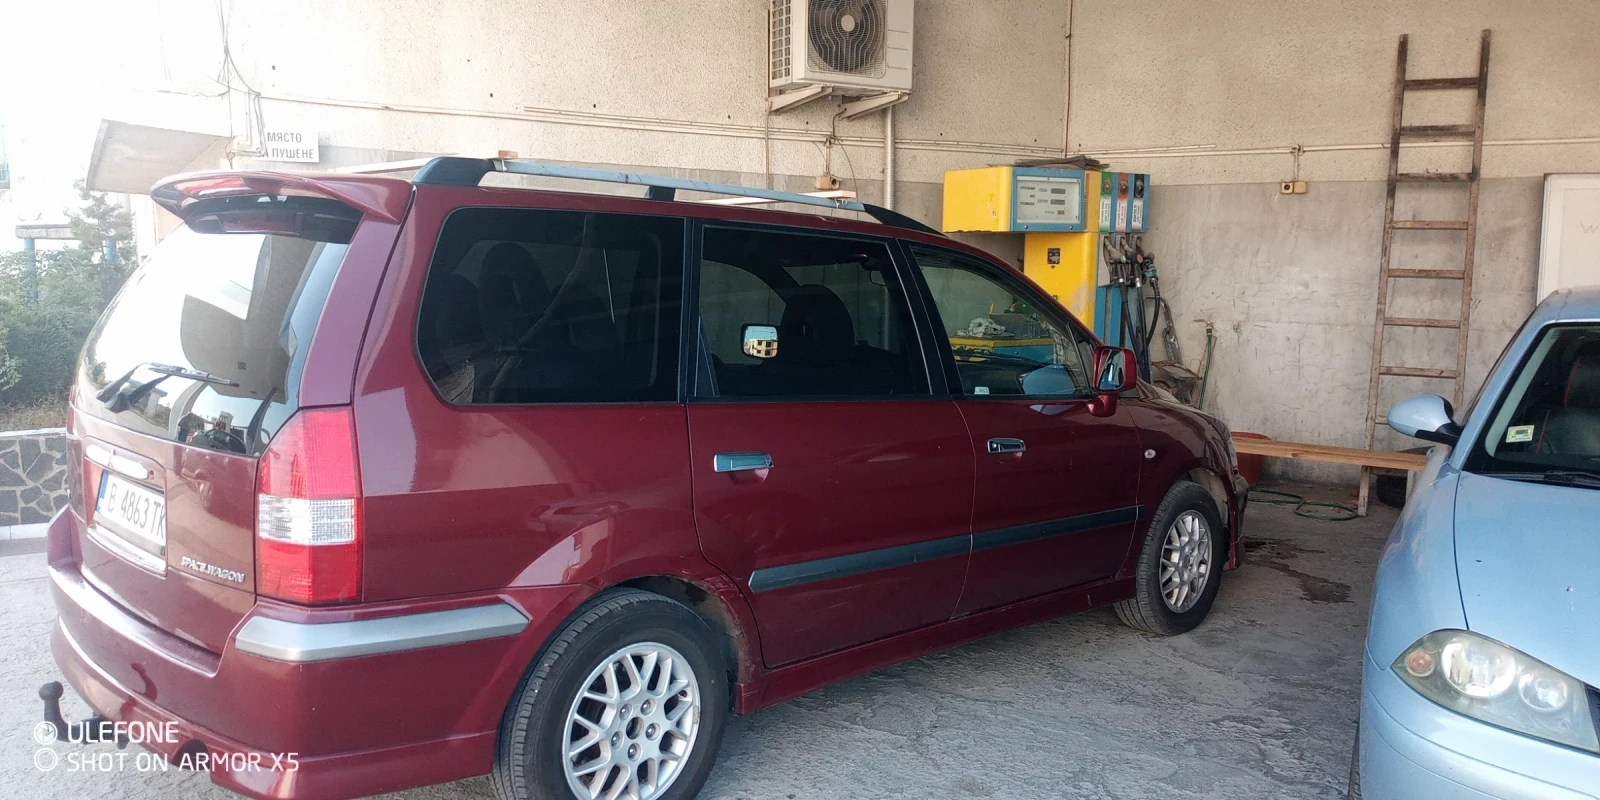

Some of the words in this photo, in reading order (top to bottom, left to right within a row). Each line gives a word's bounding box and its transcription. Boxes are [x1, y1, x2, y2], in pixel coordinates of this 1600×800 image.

[267, 132, 302, 143] МЯСТО
[272, 148, 314, 159] ПУШЕНЕ
[120, 489, 150, 529] 4863
